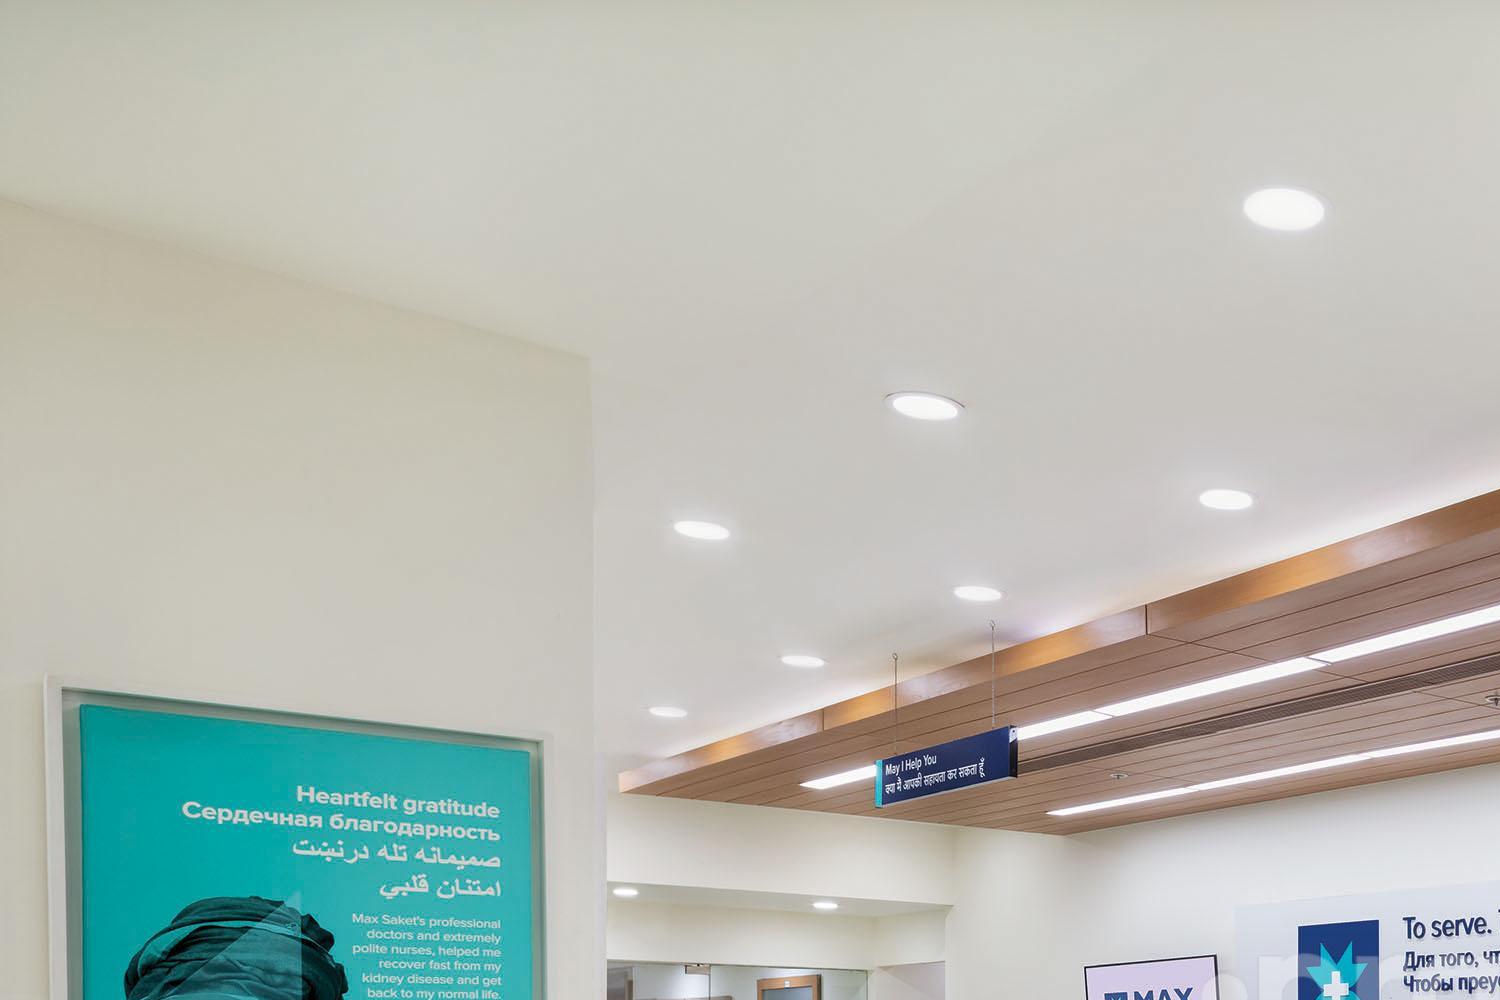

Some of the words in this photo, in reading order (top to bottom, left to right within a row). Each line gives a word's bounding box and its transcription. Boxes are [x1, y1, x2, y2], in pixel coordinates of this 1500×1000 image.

[885, 763, 900, 776] May
[905, 757, 922, 771] Help
[923, 754, 937, 766] You
[884, 783, 896, 794] क्या
[902, 773, 923, 790] आपकी
[923, 771, 946, 786] सहायता
[947, 769, 957, 780] कर
[958, 764, 978, 777] सकता
[297, 785, 397, 809] Heartfelt
[403, 798, 500, 819] gratitude
[181, 801, 323, 828] Сердечная
[330, 814, 500, 841] благодарность
[379, 873, 429, 899] قلبي
[436, 879, 500, 899] امتنان
[352, 913, 378, 924] Max
[382, 914, 425, 926] Saket's
[429, 918, 501, 929] professional
[1402, 917, 1426, 939] To
[1431, 917, 1492, 938] serve.
[366, 929, 413, 940] doctors
[417, 931, 440, 941] and
[443, 934, 501, 944] extremely
[352, 944, 387, 956] polite
[391, 948, 435, 957] nurses,
[439, 946, 480, 958] helped
[483, 949, 501, 957] me
[1403, 951, 1435, 971] Для
[1439, 952, 1479, 968] того,
[379, 960, 426, 970] recover
[429, 960, 451, 970] fast
[454, 961, 480, 971] from
[484, 964, 501, 973] my
[362, 973, 403, 985] kidney
[407, 974, 454, 985] disease
[457, 976, 480, 985] and
[482, 977, 501, 987] get
[1403, 974, 1453, 992] Чтобы
[367, 988, 397, 998] back
[401, 989, 413, 998] to
[416, 990, 435, 1000] my
[438, 989, 479, 999] normal
[482, 989, 501, 1000] life.
